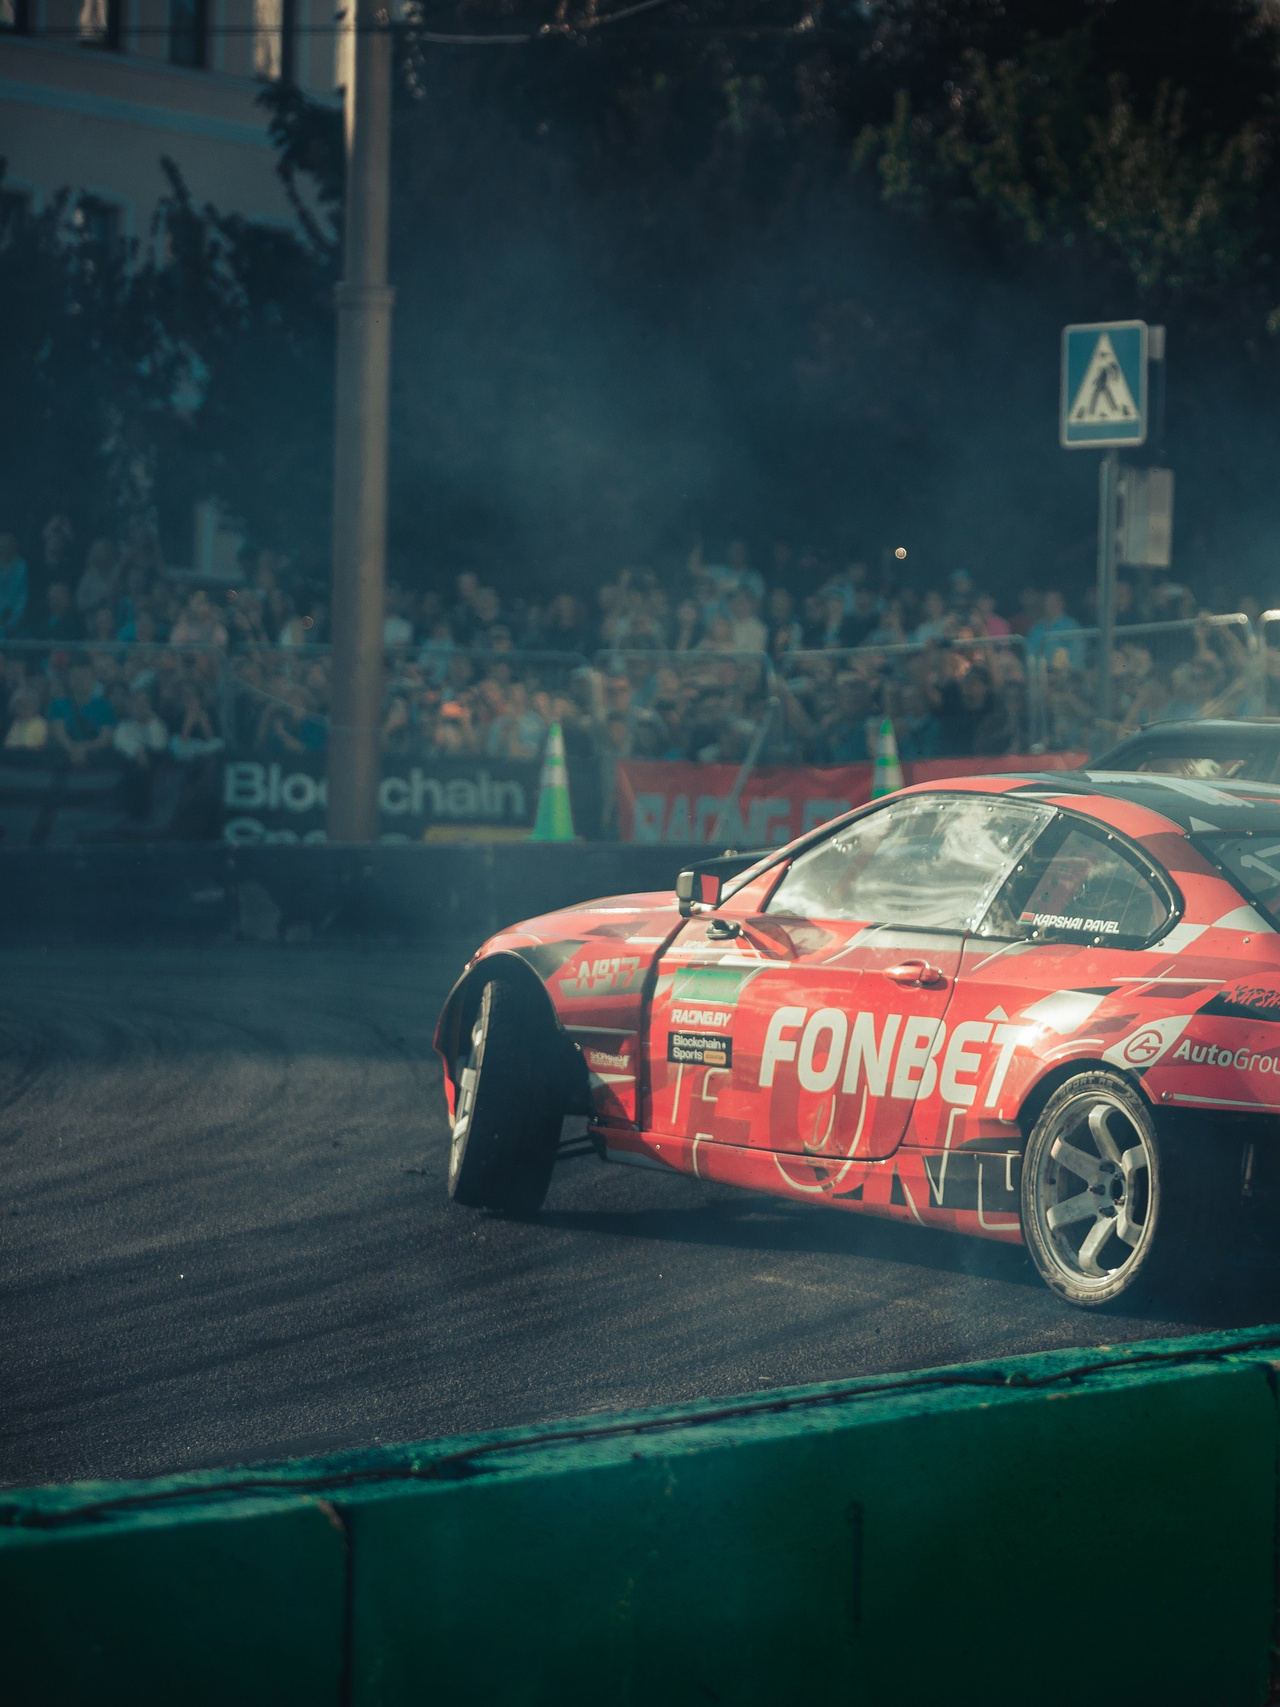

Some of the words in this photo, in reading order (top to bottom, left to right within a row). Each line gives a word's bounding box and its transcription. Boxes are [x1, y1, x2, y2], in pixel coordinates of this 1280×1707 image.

[1032, 913, 1084, 930] KAPSHAI
[1082, 918, 1120, 934] PAVEL
[673, 1034, 721, 1050] Blockchain
[673, 1046, 703, 1061] Sports
[759, 1004, 1039, 1108] FONBET
